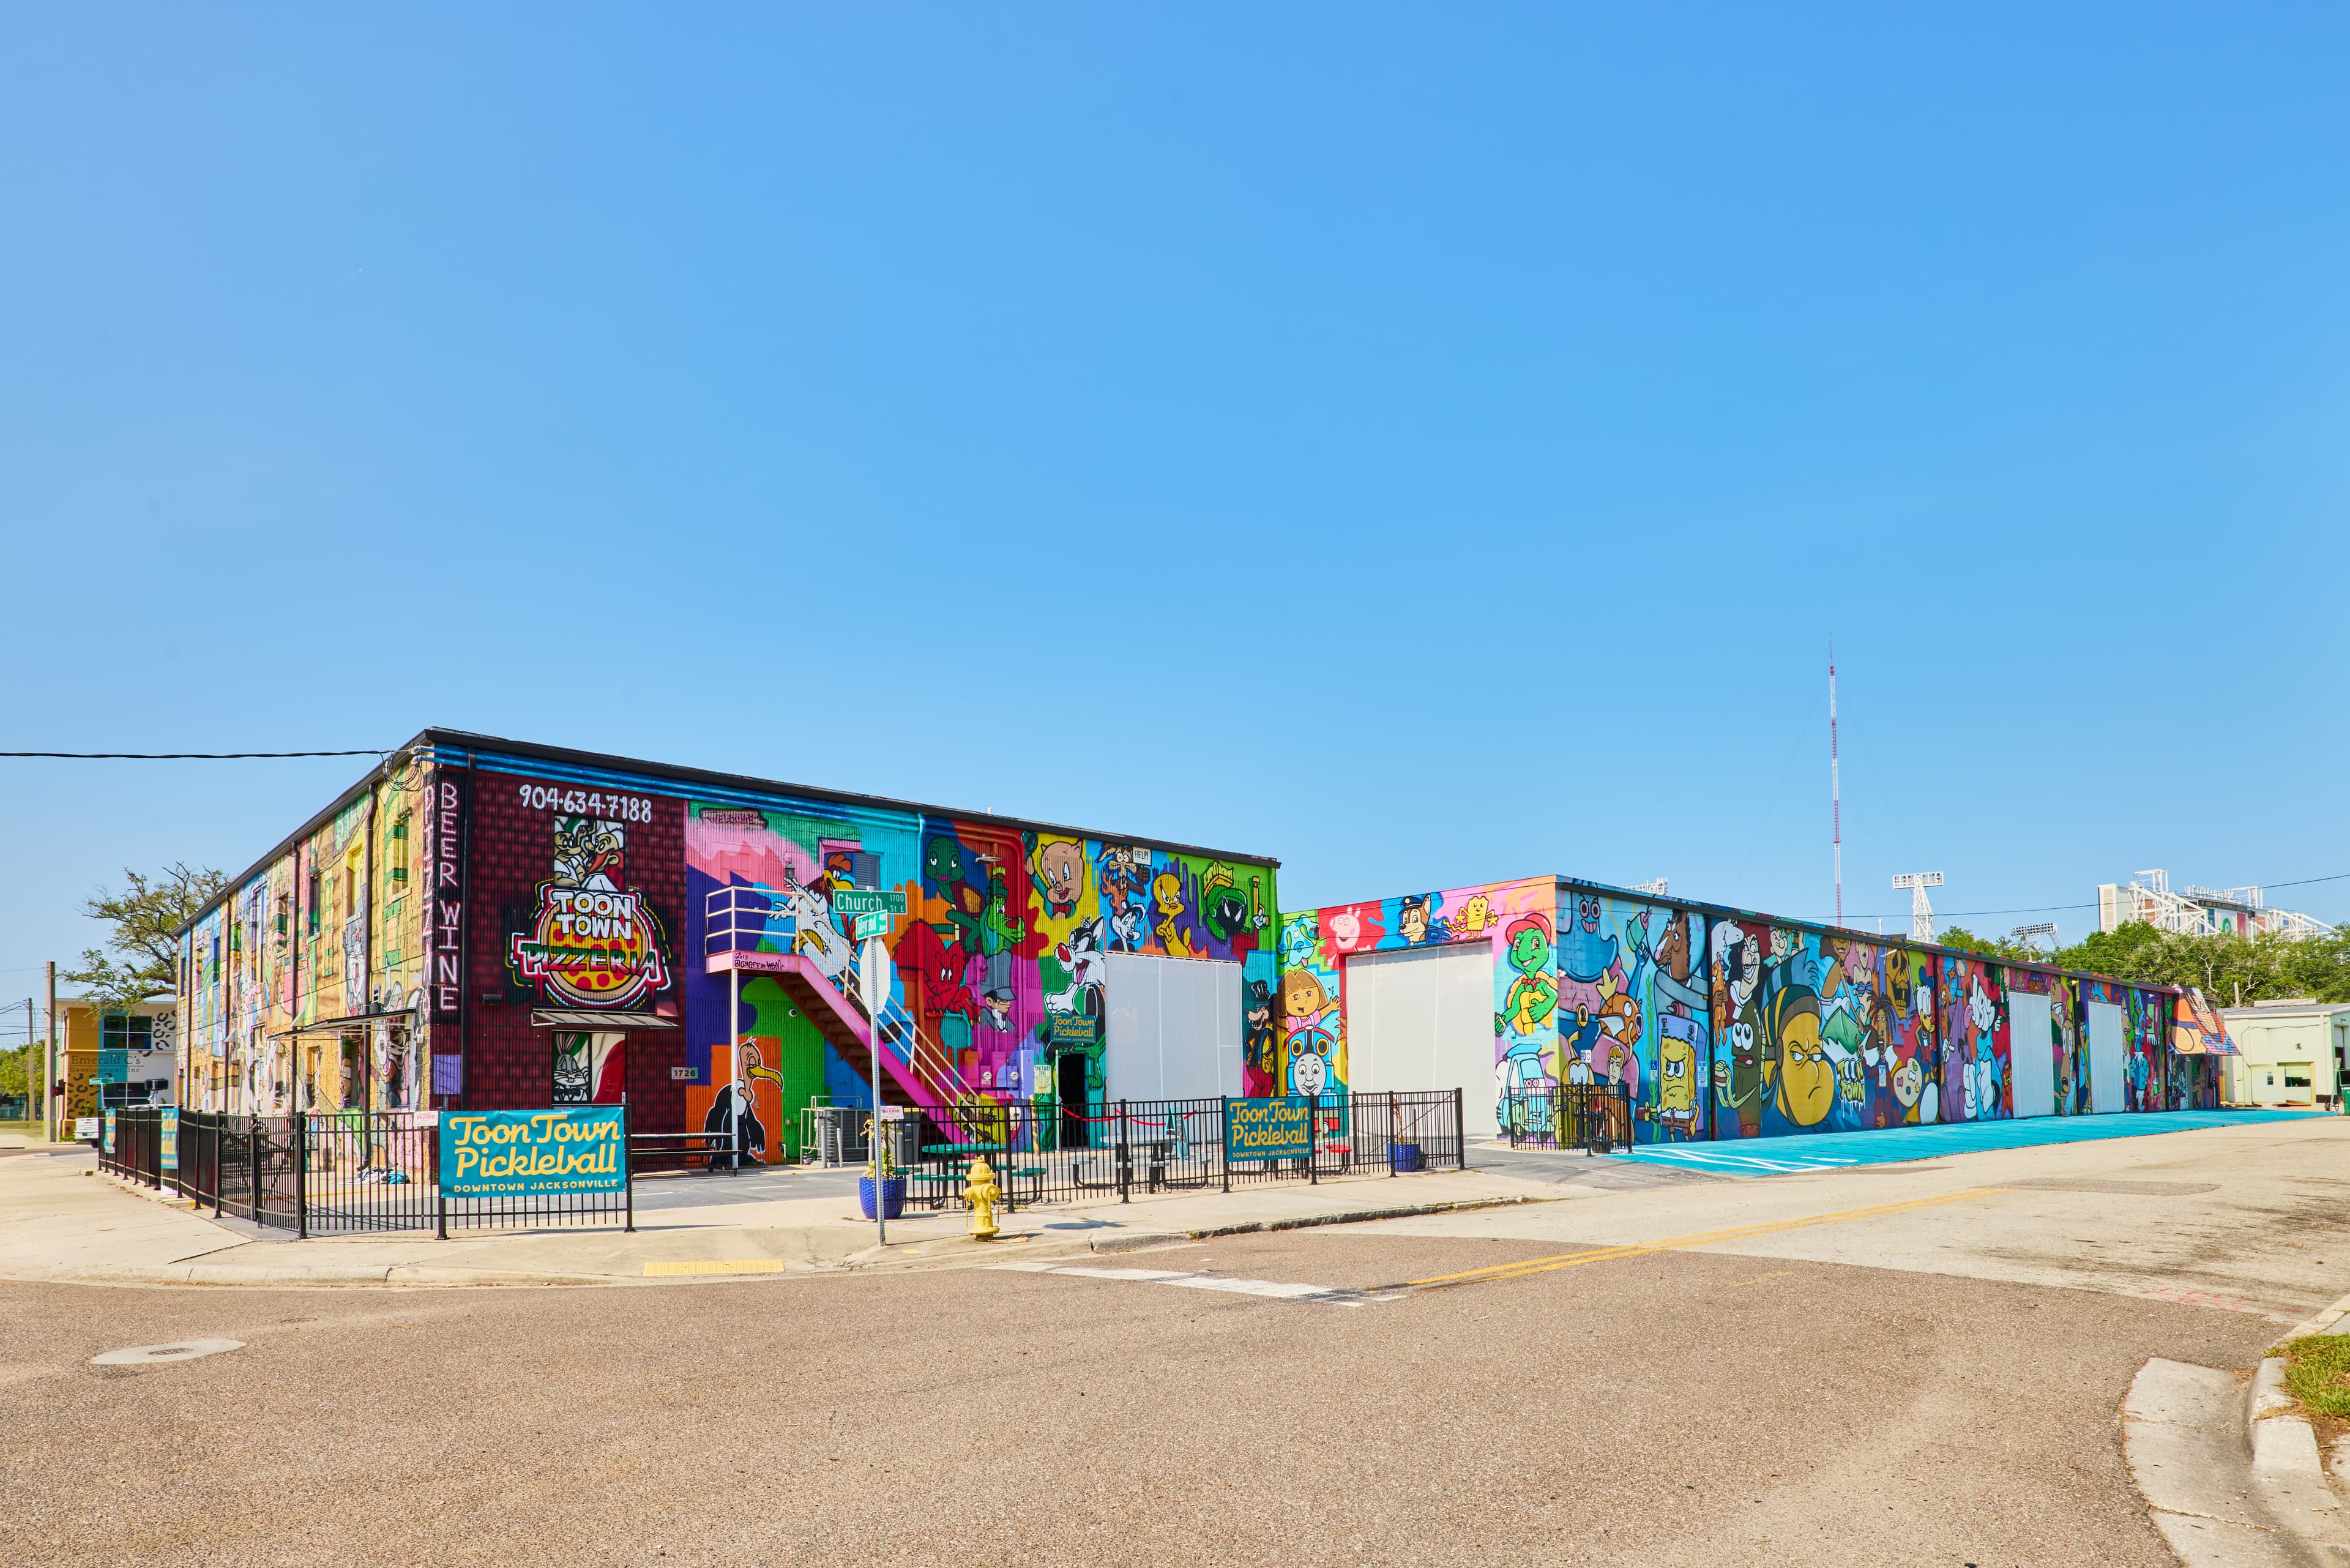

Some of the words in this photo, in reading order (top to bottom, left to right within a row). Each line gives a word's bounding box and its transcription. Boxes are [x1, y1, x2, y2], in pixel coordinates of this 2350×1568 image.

[439, 782, 458, 887] BEER
[1135, 850, 1149, 860] HELP!
[553, 890, 633, 919] TOON
[837, 894, 882, 911] Church
[556, 914, 633, 940] TOWN
[438, 900, 460, 1010] WINE
[520, 943, 657, 976] PIZZERIA
[1053, 1015, 1072, 1025] Toon
[1072, 1017, 1094, 1026] Town
[1053, 1025, 1094, 1037] Pickleball
[71, 1055, 121, 1064] Emerald
[1840, 1080, 1864, 1102] TOWN
[1229, 1102, 1269, 1123] Toon
[1269, 1102, 1309, 1122] Town
[449, 1116, 531, 1145] Toon
[531, 1114, 621, 1143] Town
[1231, 1122, 1308, 1147] Pickleball
[454, 1143, 617, 1178] Pickleball
[454, 1183, 524, 1193] DOWNTOWN
[531, 1179, 617, 1190] JACKSONVILLE
